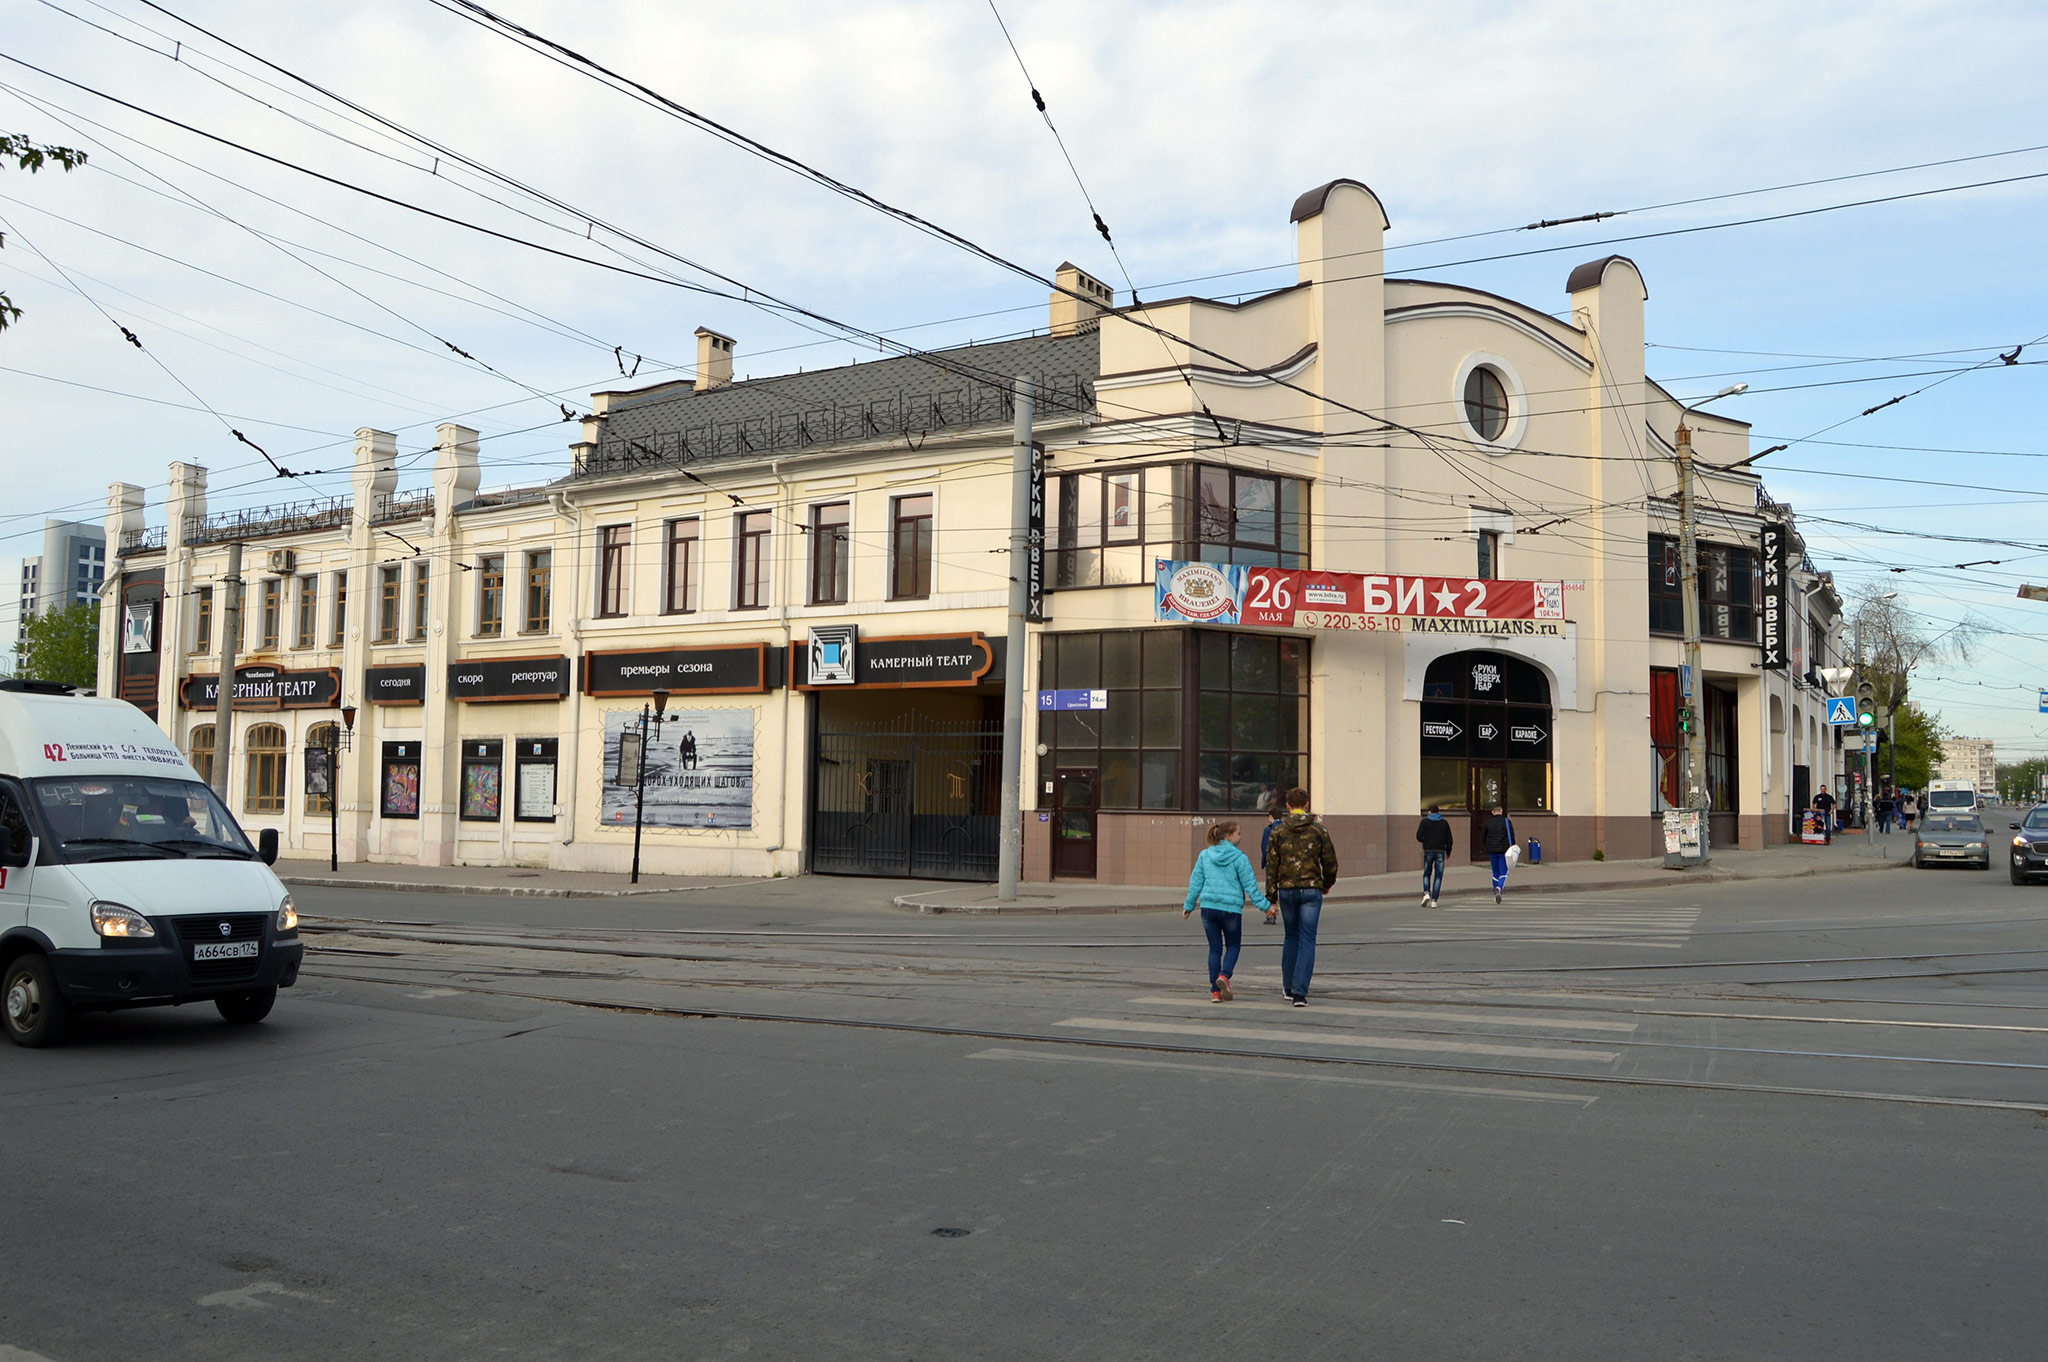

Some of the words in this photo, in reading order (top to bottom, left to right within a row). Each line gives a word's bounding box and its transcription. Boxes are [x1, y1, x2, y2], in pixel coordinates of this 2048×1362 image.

[1031, 448, 1042, 519] РУКИ
[1764, 531, 1779, 587] РУКИ
[1249, 575, 1291, 610] 26
[1363, 576, 1425, 615] БИ
[1464, 580, 1488, 617] 2
[1178, 593, 1220, 608] BRAUEREI
[1258, 611, 1283, 622] МАЯ
[1323, 613, 1401, 632] 220-35-10
[1411, 617, 1558, 636] MAXIMILIANS.ru
[1765, 595, 1779, 664] ВВЕРХ
[870, 654, 933, 669] КАМЕРНЫЙ
[936, 655, 973, 666] ТЕАТР
[1478, 664, 1497, 674] РУКИ
[620, 664, 670, 678] премьеры
[677, 662, 713, 673] сезона
[380, 678, 411, 688] сегодня
[457, 674, 484, 686] скоро
[511, 670, 558, 683] репертуар
[205, 679, 274, 699] КАЕРНЫЙ
[276, 680, 317, 697] ТЕАТР
[1478, 682, 1492, 691] БАР
[1041, 695, 1053, 706] 15
[1425, 725, 1454, 736] РЕСТОРАН
[1481, 727, 1493, 736] БАР
[1514, 729, 1538, 739] КАРАОКЕ
[44, 743, 67, 762] 42
[66, 743, 101, 751] Ленинский
[142, 746, 179, 758] ТЕПЛОТЕХ
[70, 752, 102, 760] Больница
[146, 755, 184, 766] ЧВВАКУШ
[855, 771, 873, 796] К
[41, 785, 75, 802] 42
[198, 945, 239, 958] А664СВ
[241, 943, 257, 952] 174
